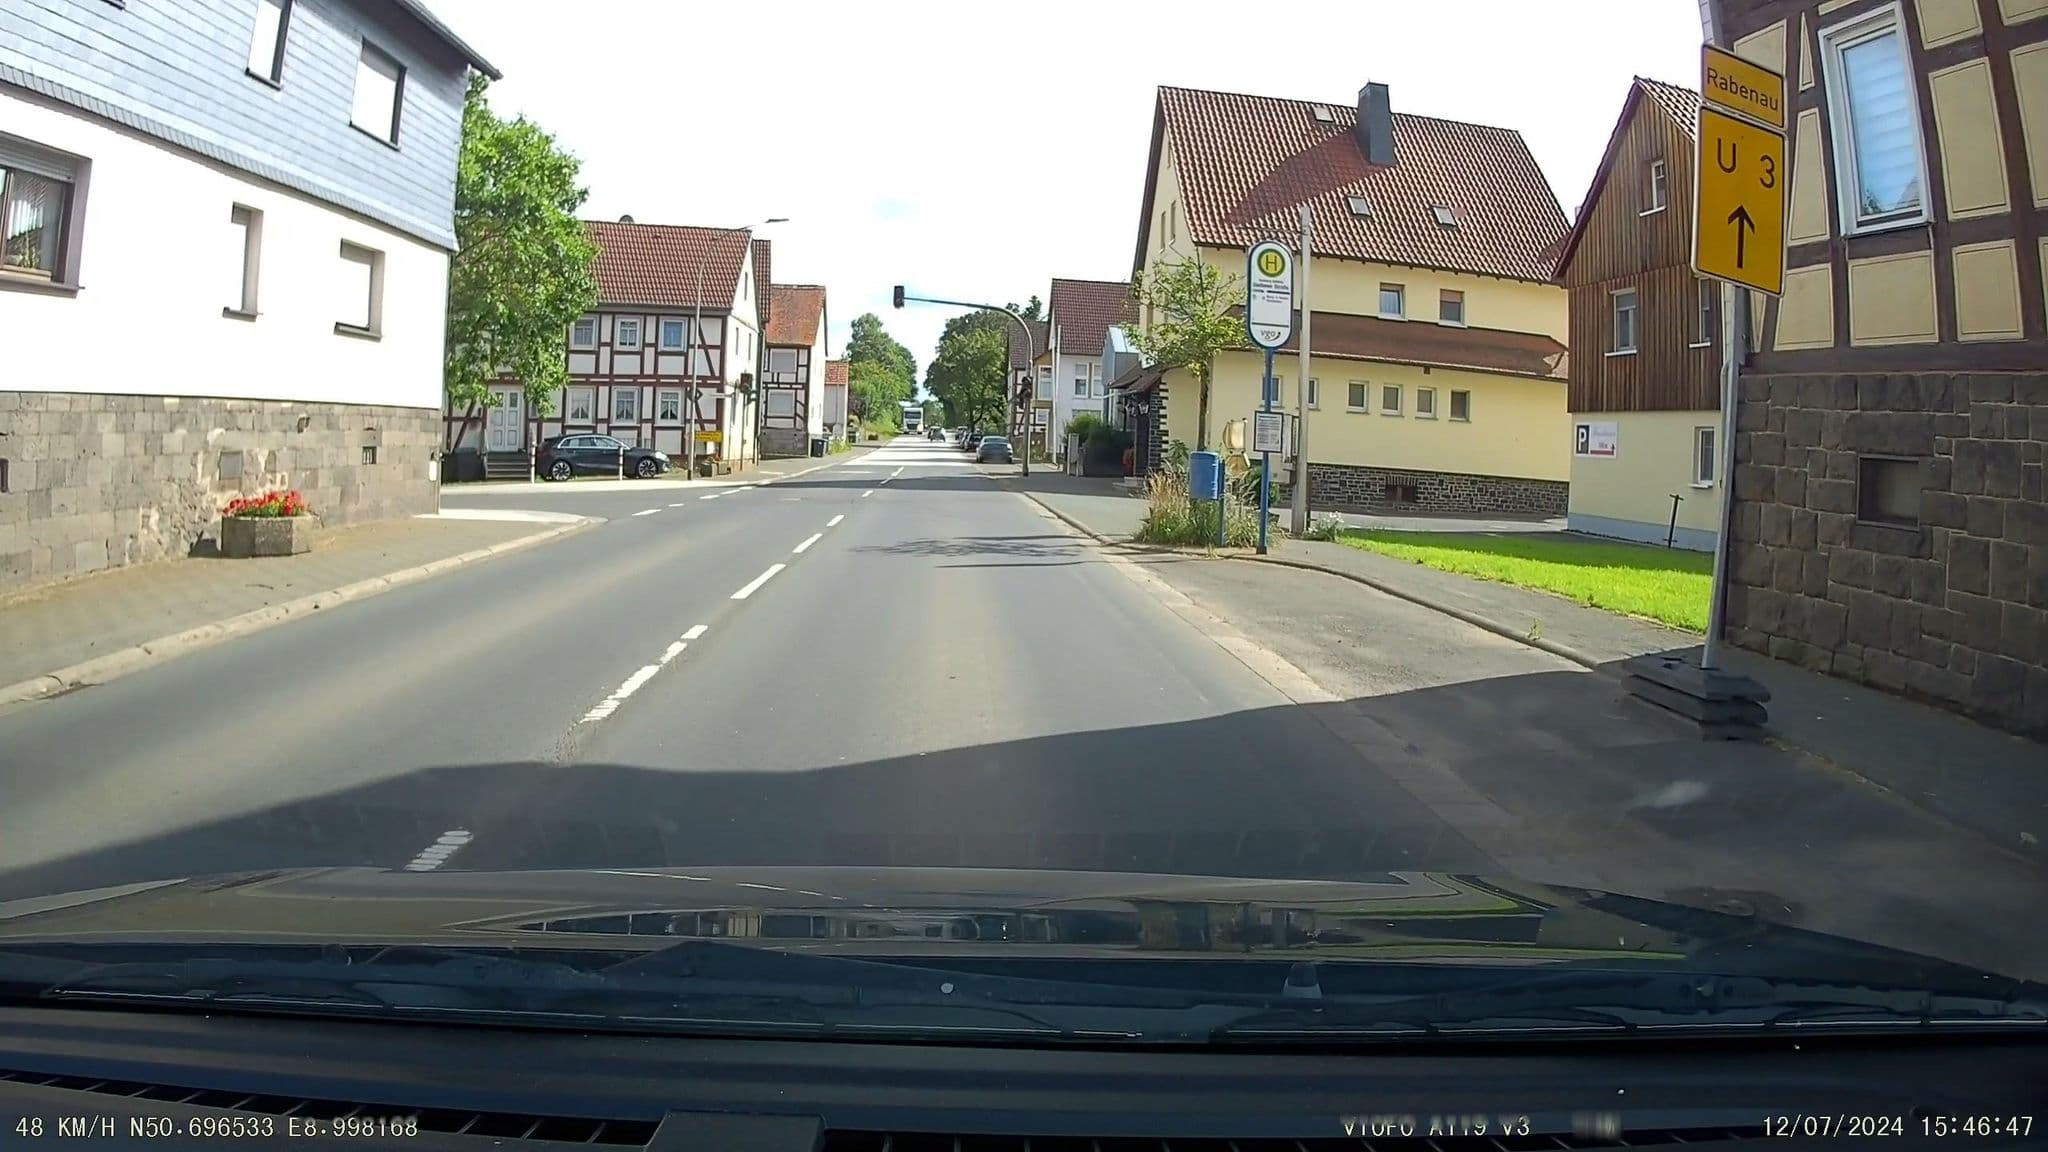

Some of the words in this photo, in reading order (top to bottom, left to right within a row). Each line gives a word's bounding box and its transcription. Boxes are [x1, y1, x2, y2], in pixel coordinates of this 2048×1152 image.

[1706, 66, 1779, 112] Rabenau
[1717, 137, 1737, 174] U
[1759, 154, 1775, 189] 3
[1265, 254, 1278, 272] H
[1578, 427, 1587, 452] P
